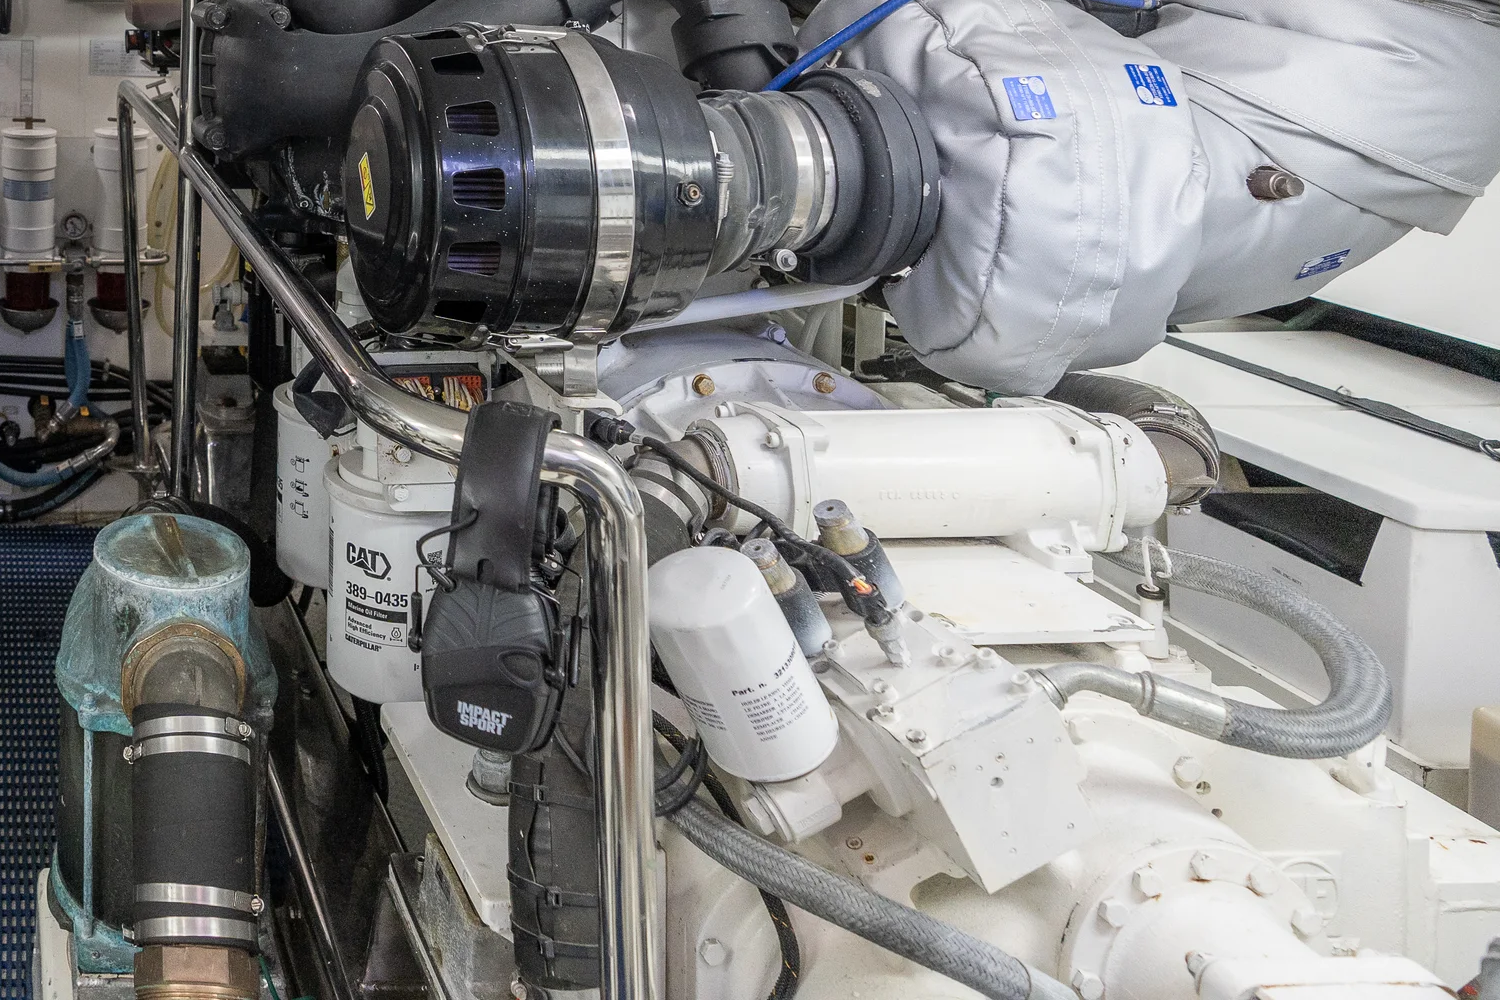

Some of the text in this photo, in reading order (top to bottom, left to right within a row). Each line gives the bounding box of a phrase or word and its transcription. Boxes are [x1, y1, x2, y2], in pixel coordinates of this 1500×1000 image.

[346, 542, 380, 573] CAT
[345, 580, 409, 608] 389-0435
[347, 601, 388, 619] Marine Oil Filter
[347, 615, 372, 630] Advanced
[347, 621, 386, 641] High Efficiency
[731, 687, 755, 697] Part.
[457, 700, 509, 726] IMPACT
[460, 713, 505, 736] SPORT
